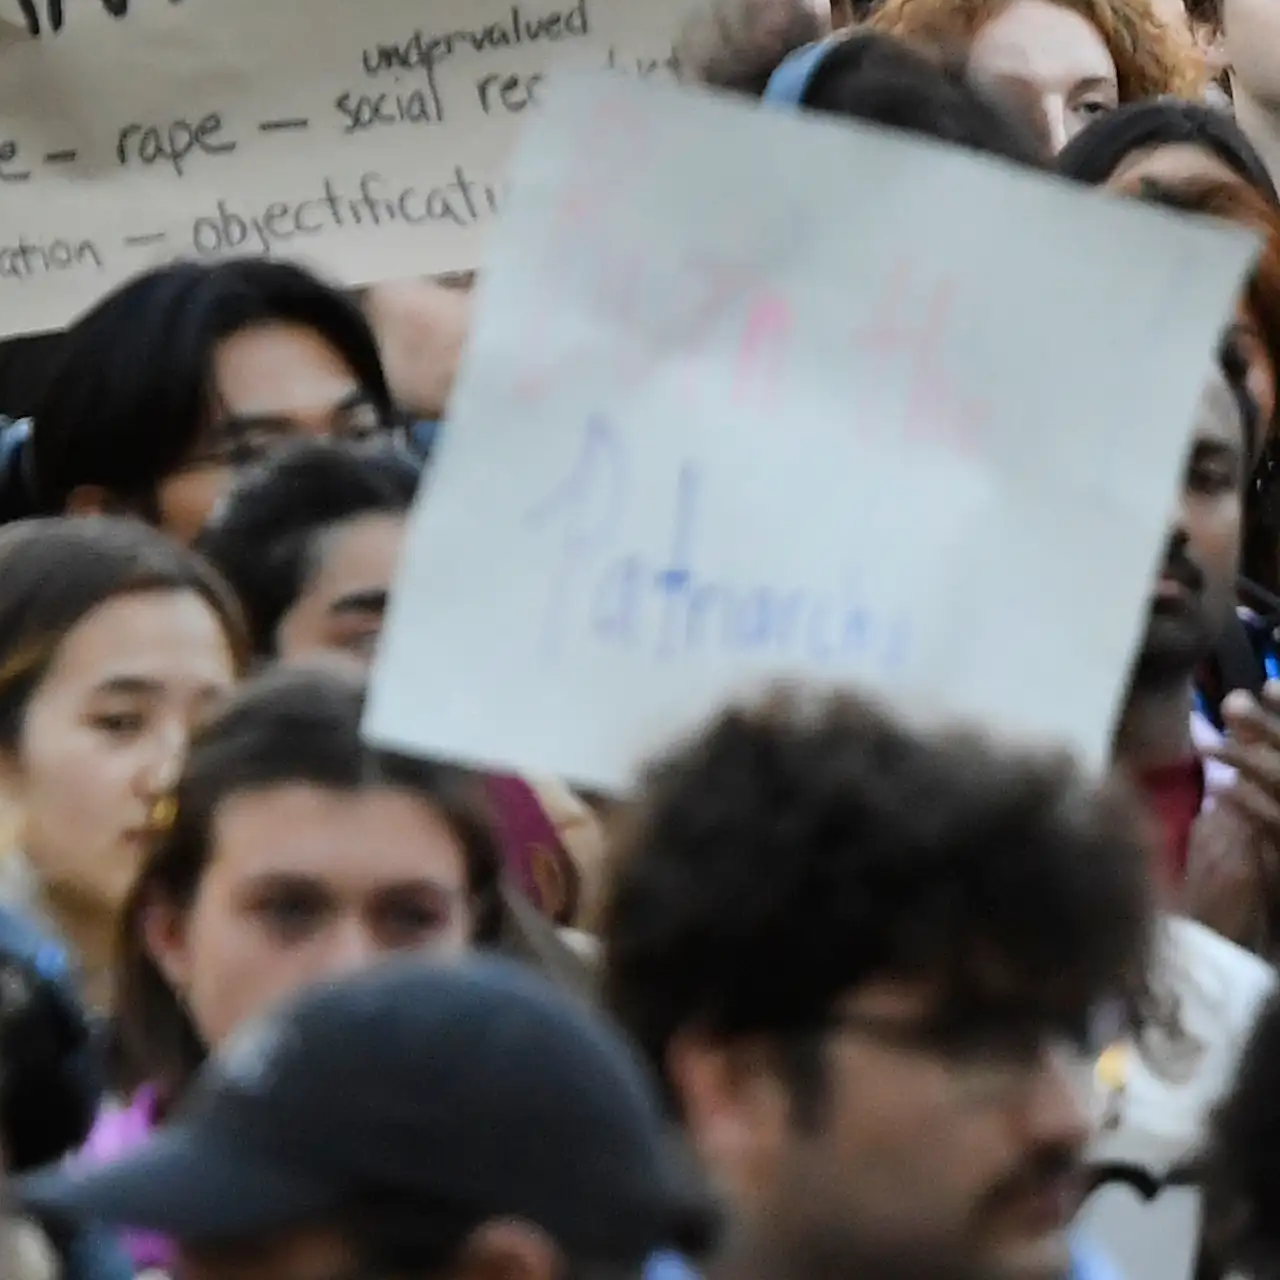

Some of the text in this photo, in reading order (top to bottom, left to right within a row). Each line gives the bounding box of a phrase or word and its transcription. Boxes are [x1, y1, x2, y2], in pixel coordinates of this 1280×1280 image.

[116, 111, 237, 177] rape
[334, 53, 443, 135] social
[192, 164, 502, 255] objectificati
